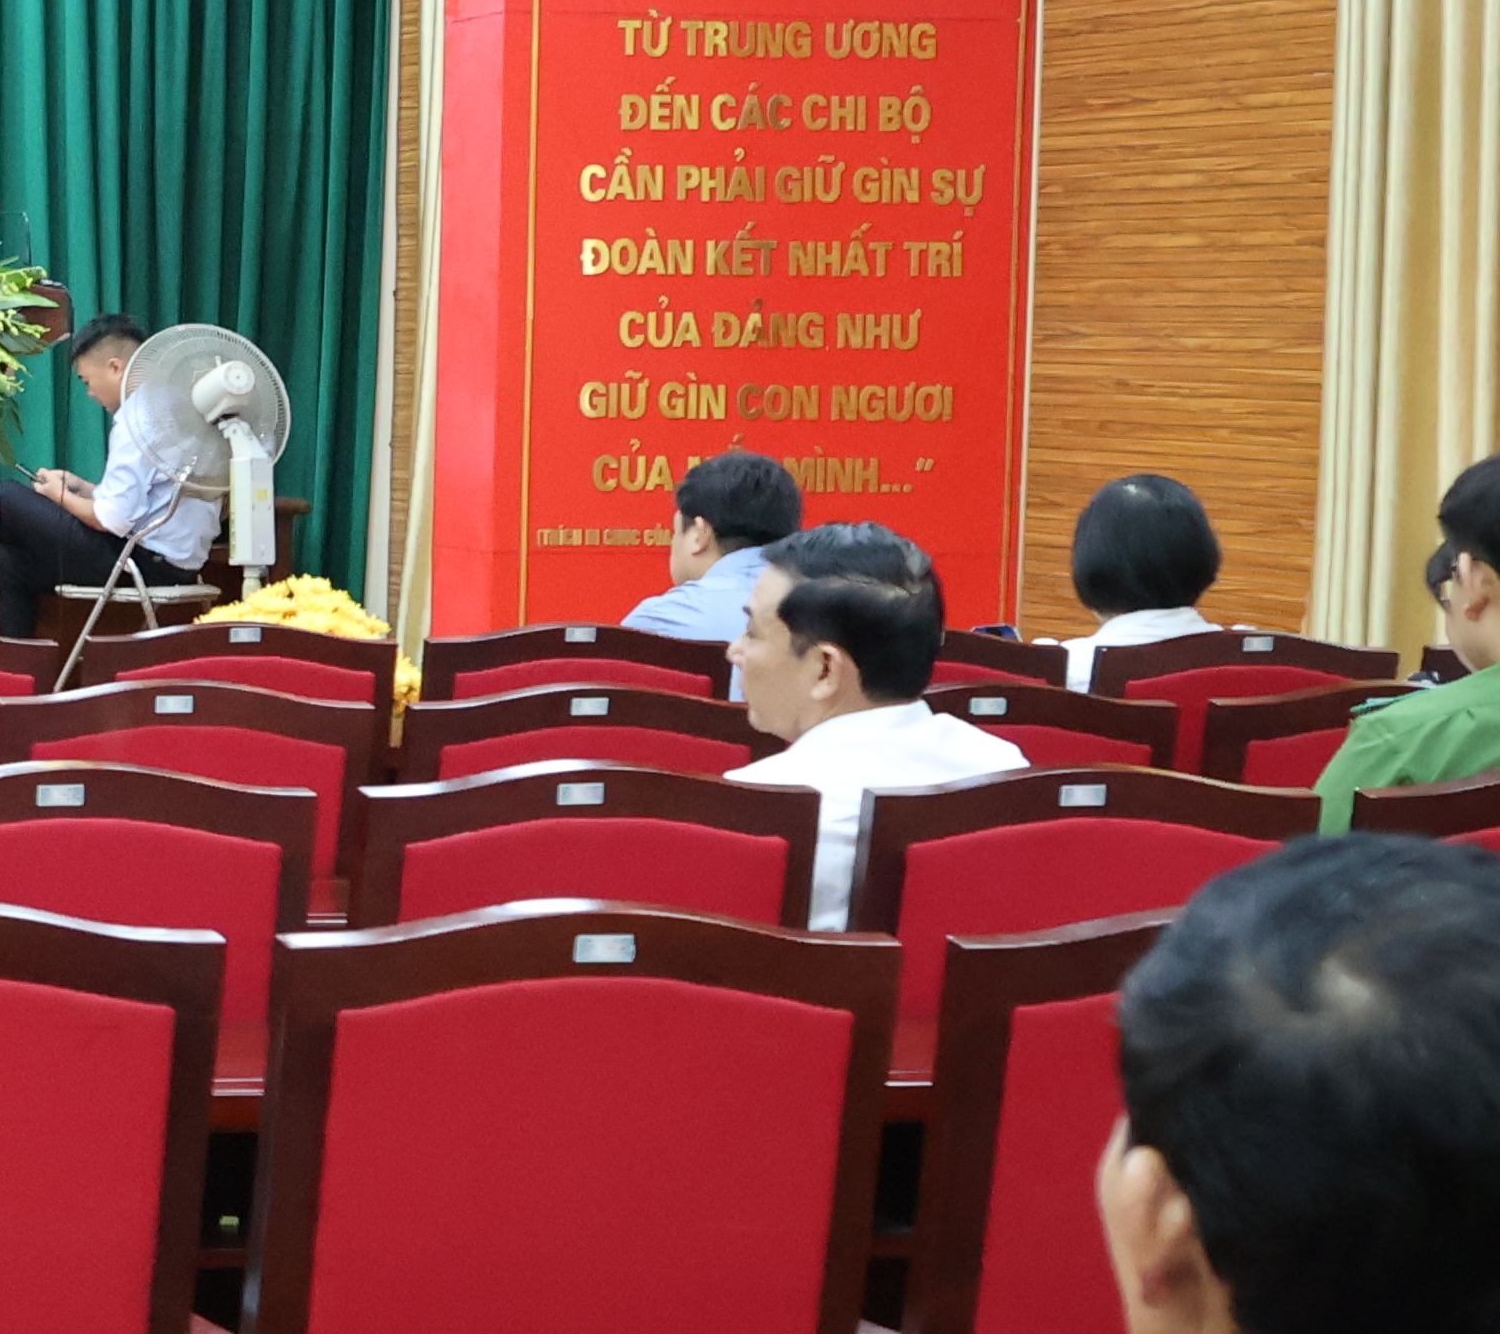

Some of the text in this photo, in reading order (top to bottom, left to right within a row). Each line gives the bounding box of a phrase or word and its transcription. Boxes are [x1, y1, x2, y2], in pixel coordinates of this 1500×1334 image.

[618, 9, 936, 58] TỪ TRUNG ƯƠNG
[619, 77, 930, 142] ĐẾN CÁC CHI BỘ
[580, 148, 985, 215] CẦN PHẢI GIỮ GÌN SỰ
[580, 222, 963, 276] ĐOÀN KẾT NHẤT TRÍ
[619, 296, 921, 349] CỦA ĐẢNG NHƯ
[579, 370, 649, 419] GIỮ
[659, 372, 726, 419] GÌN
[738, 384, 818, 419] CON
[593, 439, 674, 491] CỦA
